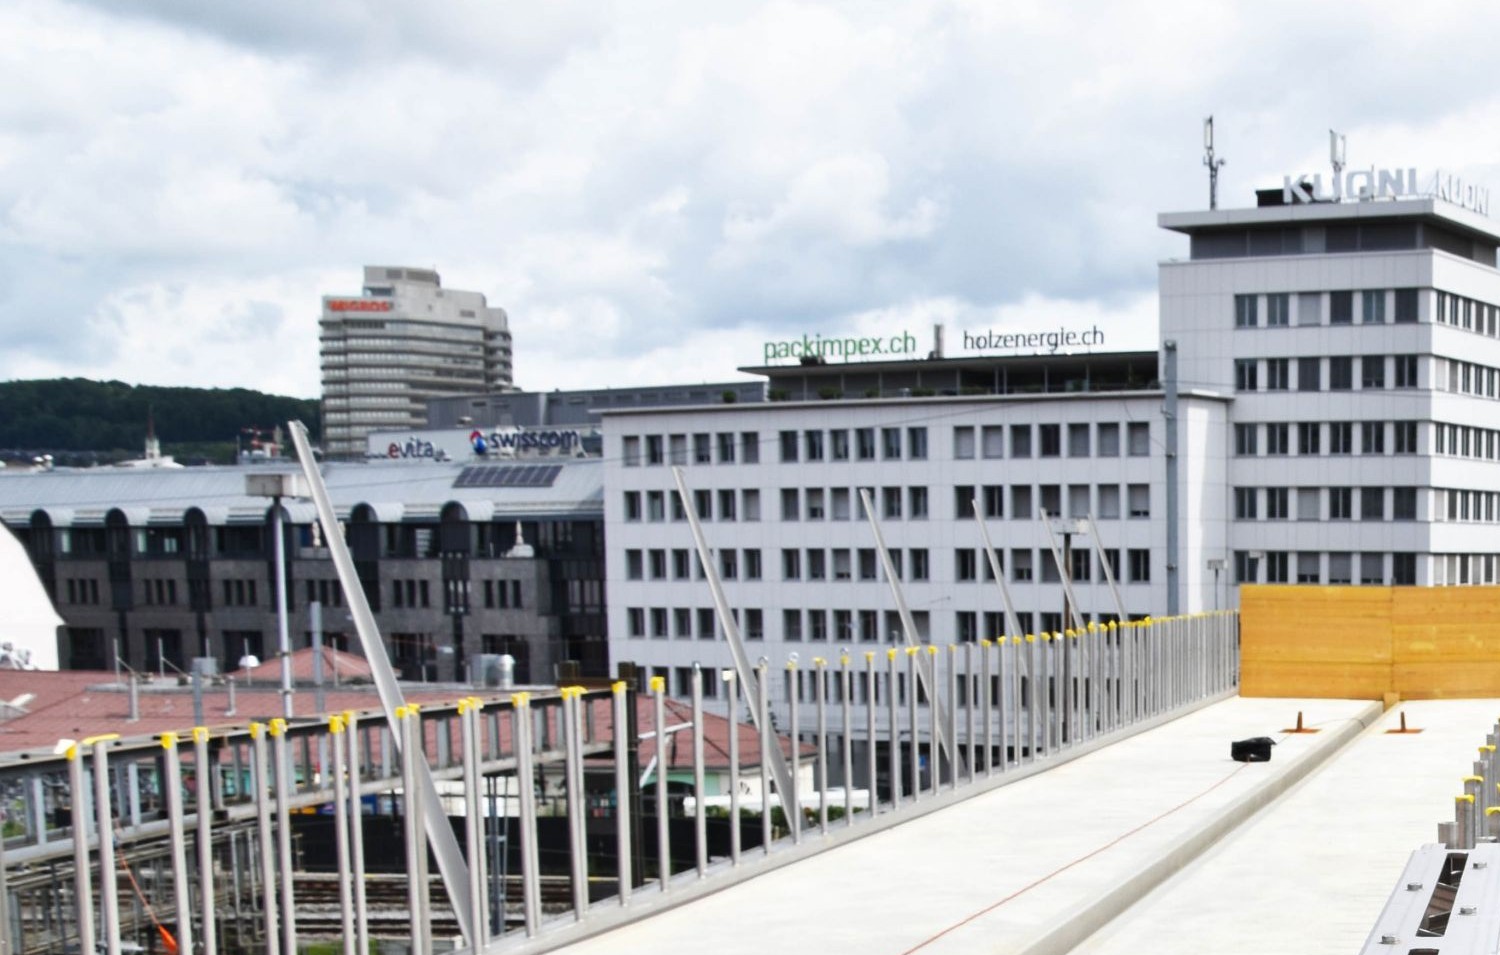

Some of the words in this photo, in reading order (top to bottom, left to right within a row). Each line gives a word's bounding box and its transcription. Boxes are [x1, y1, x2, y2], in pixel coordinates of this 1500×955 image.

[1283, 168, 1417, 204] KUONI
[764, 331, 916, 363] packimpex.ch
[963, 325, 1105, 352] holzenergie.ch
[490, 426, 578, 451] swisscom
